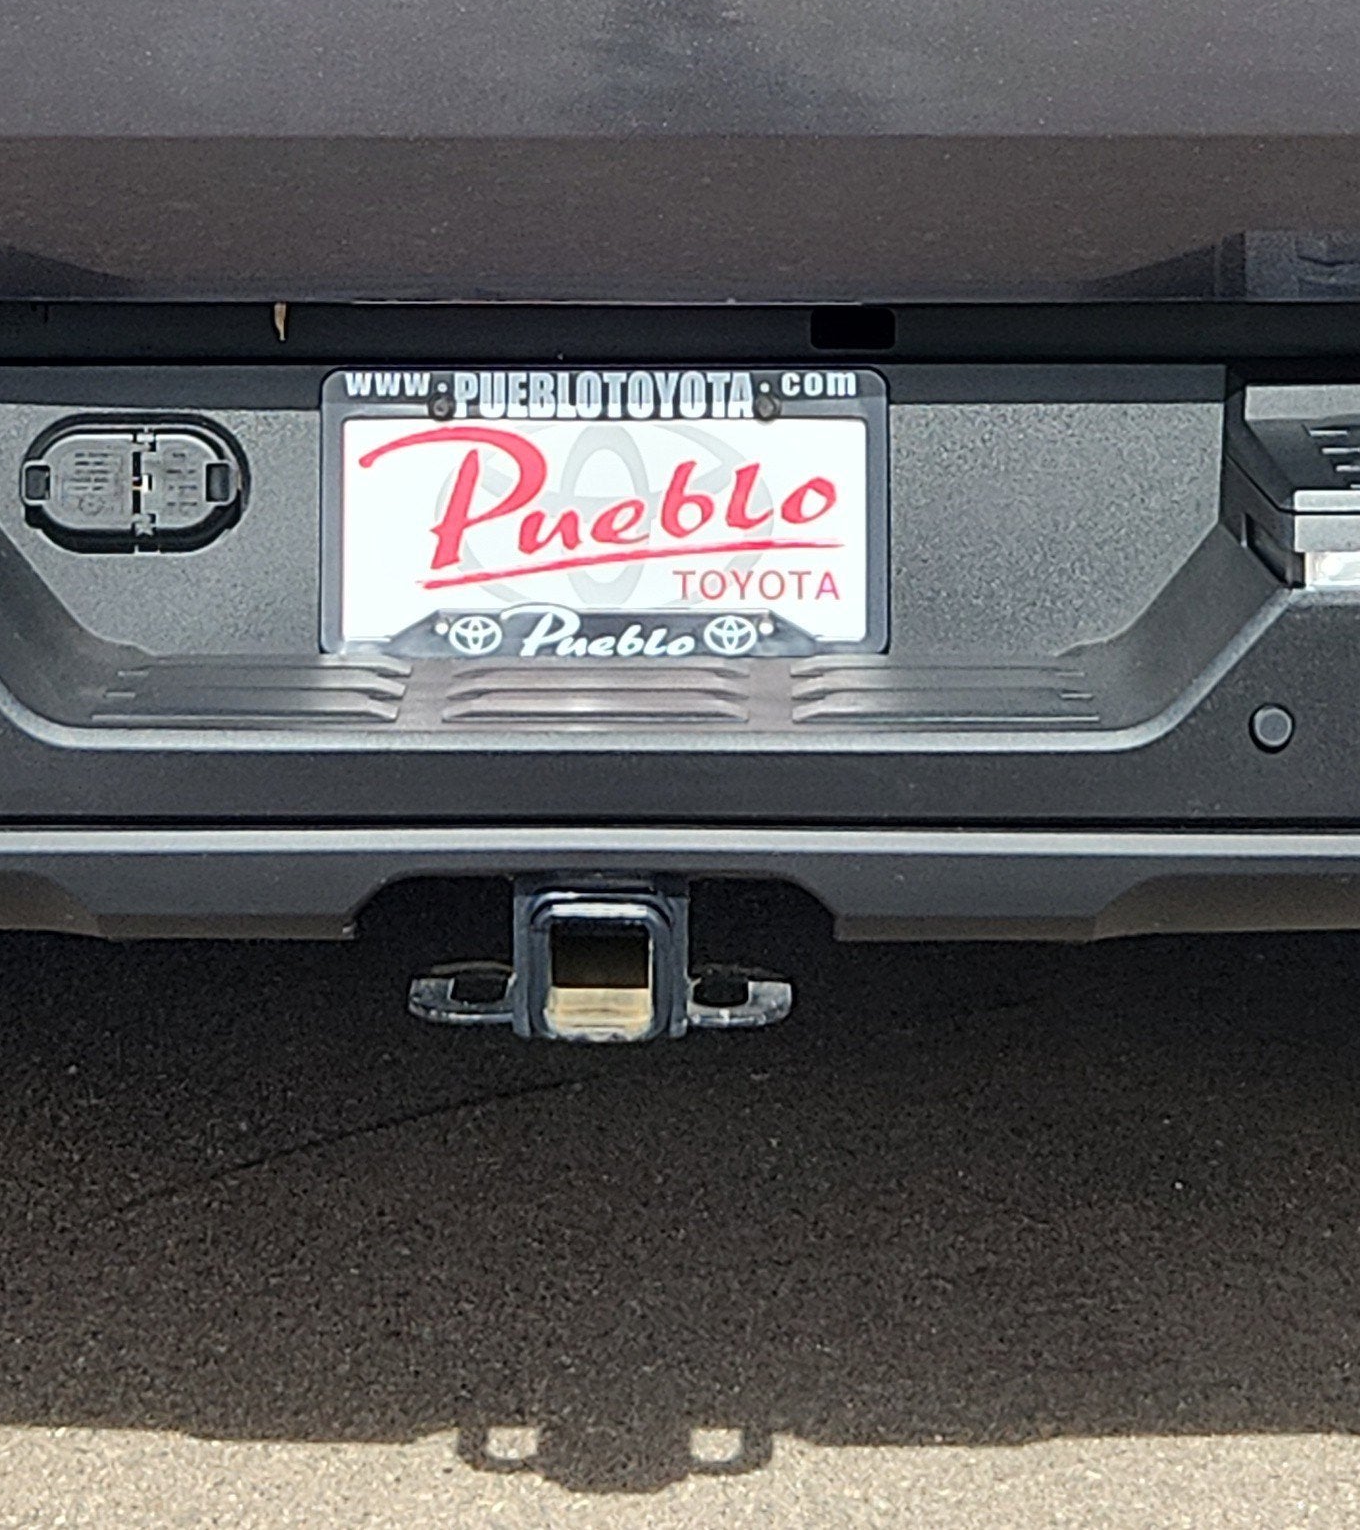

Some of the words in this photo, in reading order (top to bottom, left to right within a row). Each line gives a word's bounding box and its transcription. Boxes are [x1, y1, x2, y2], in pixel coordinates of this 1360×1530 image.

[358, 426, 838, 572] Pueblo
[673, 569, 841, 601] TOYOTA
[501, 603, 696, 658] Pueblo
